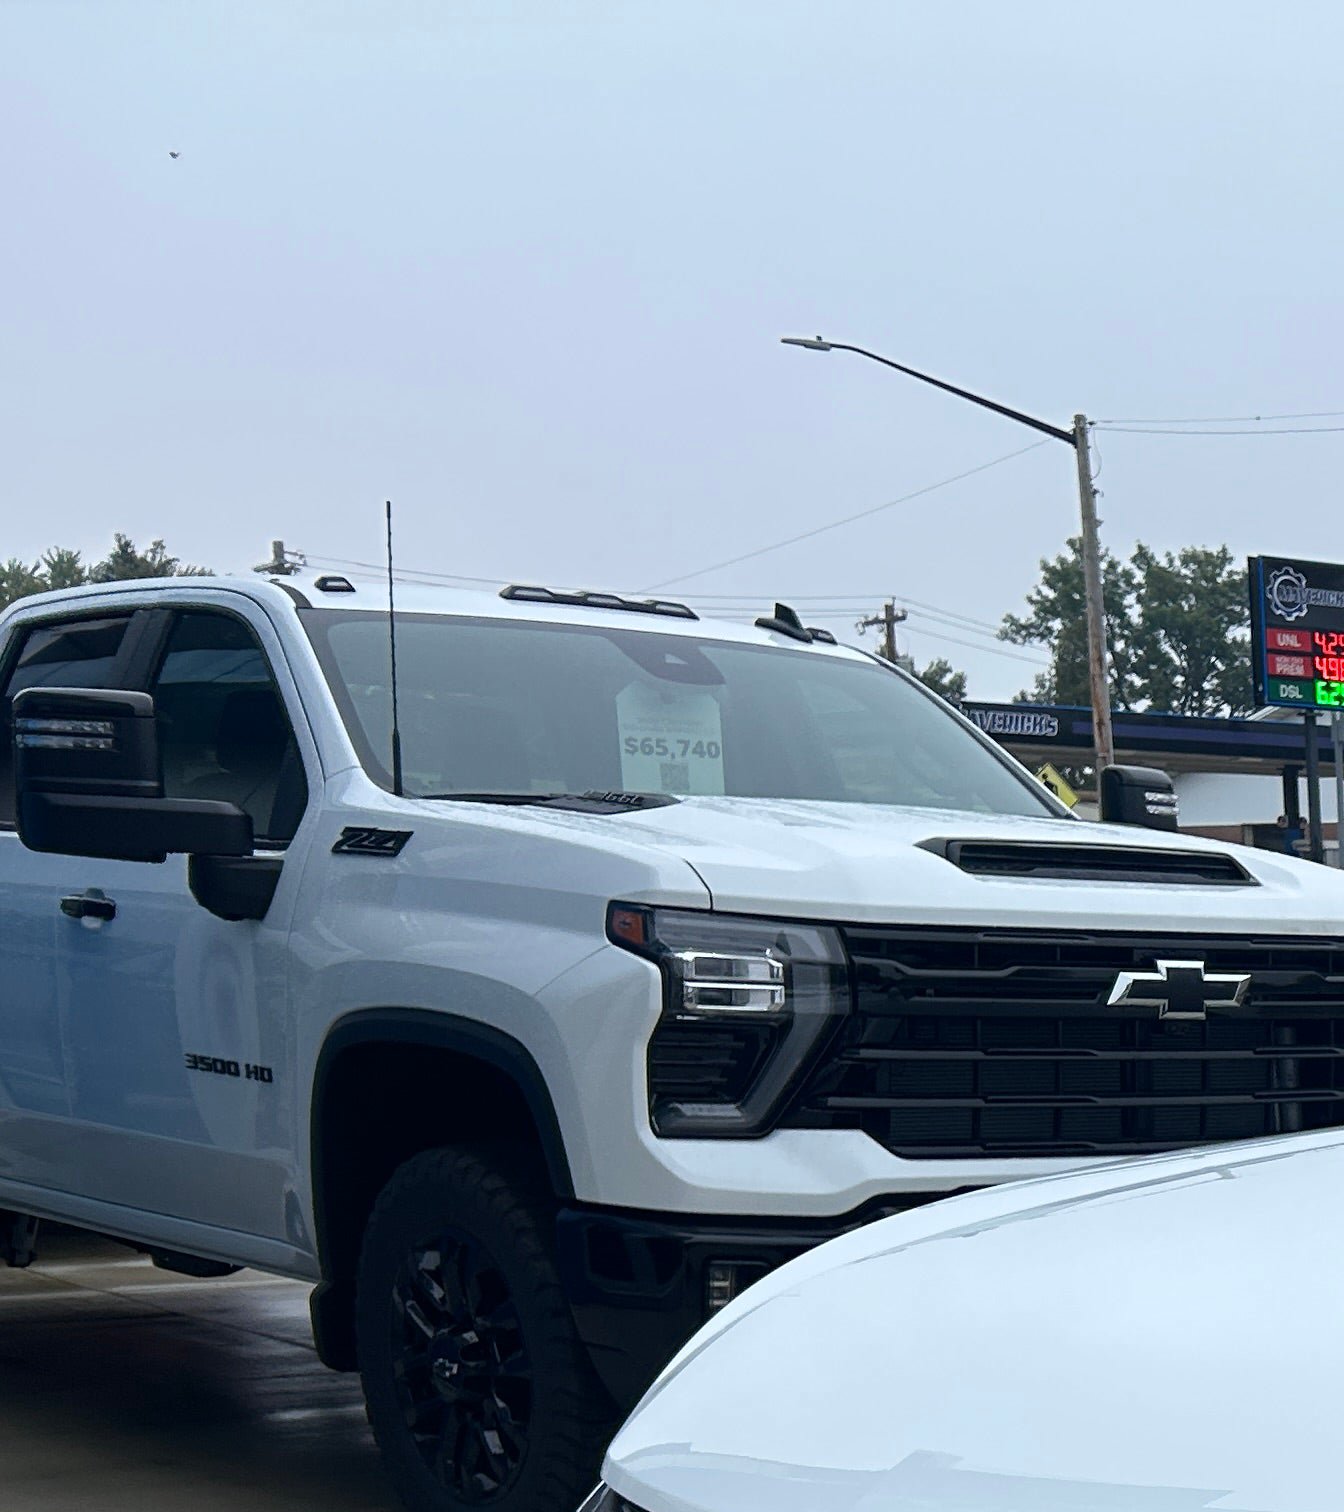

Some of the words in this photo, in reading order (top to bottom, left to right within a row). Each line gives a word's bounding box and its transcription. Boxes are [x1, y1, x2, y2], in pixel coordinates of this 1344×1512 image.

[1277, 633, 1302, 648] UNL
[1279, 684, 1304, 699] DSL
[623, 736, 721, 760] $65,740
[184, 1052, 241, 1078] 3500
[244, 1062, 274, 1084] HD
